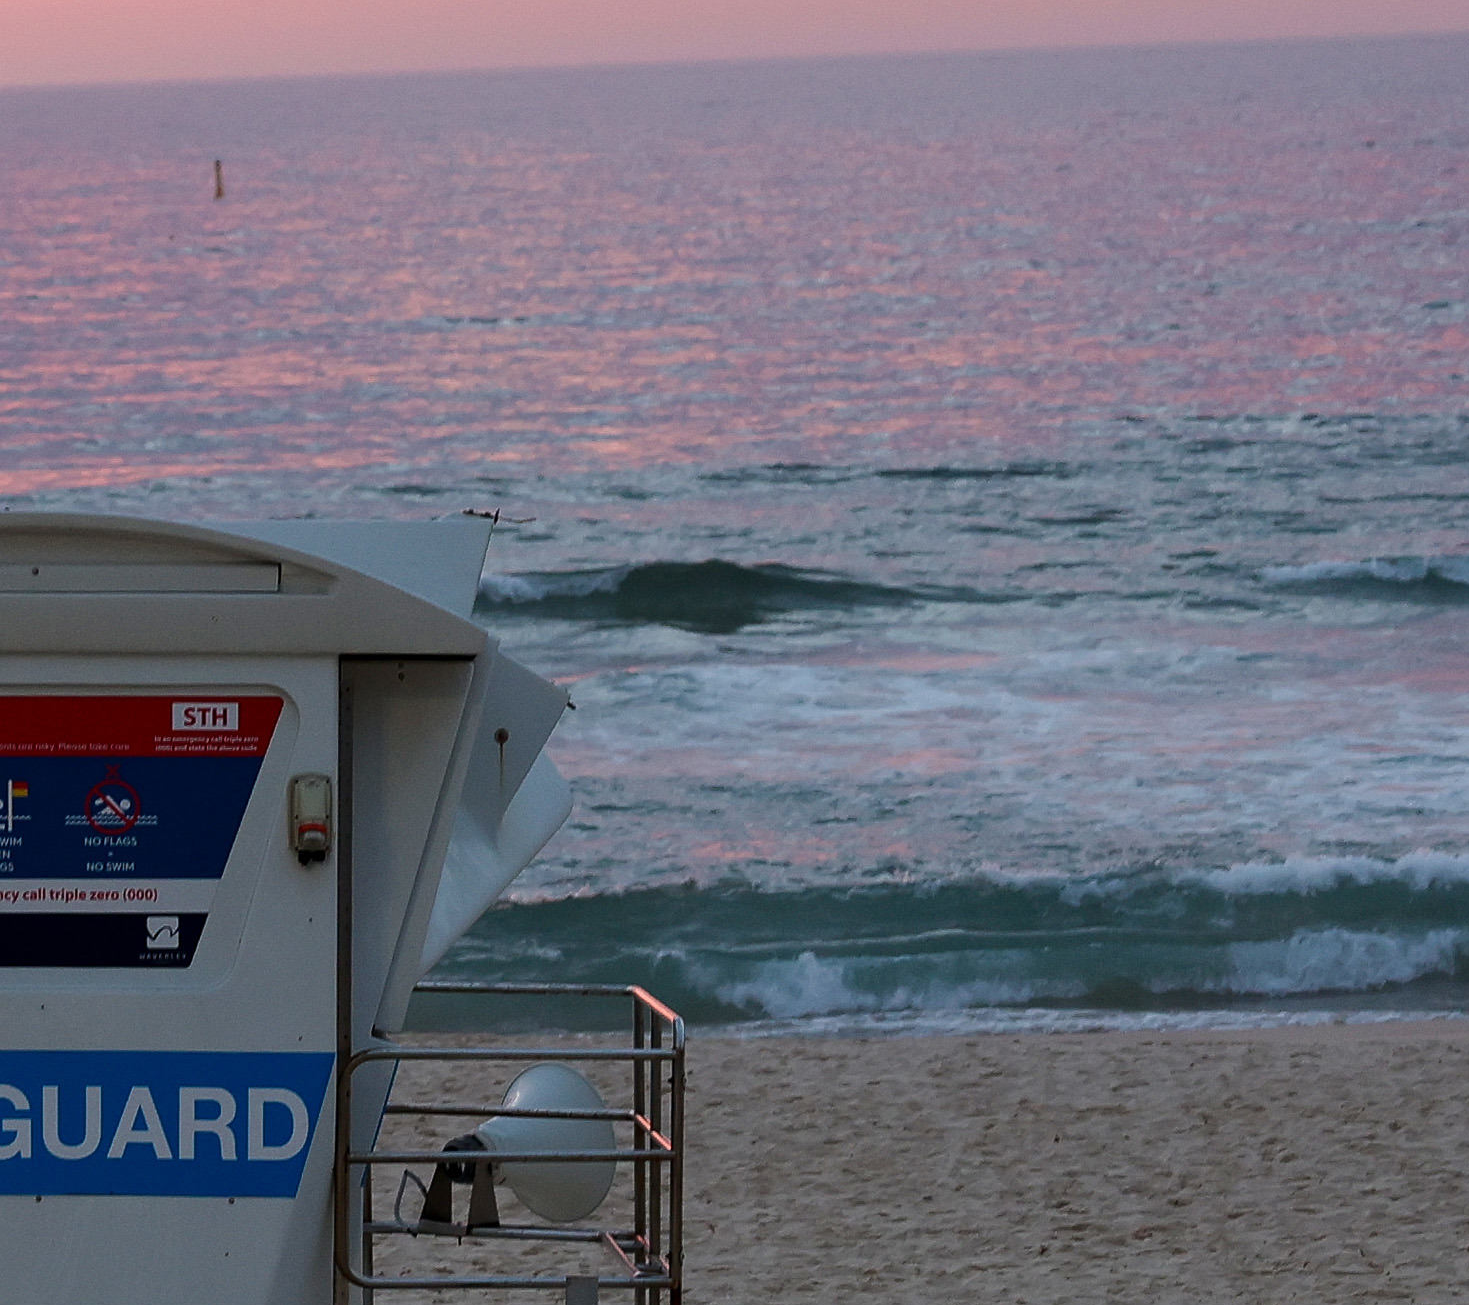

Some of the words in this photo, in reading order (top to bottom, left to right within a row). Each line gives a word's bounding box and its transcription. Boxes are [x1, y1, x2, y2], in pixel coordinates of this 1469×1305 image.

[183, 707, 228, 726] STH
[84, 836, 101, 846] NO
[103, 836, 137, 846] FLAGS
[86, 862, 103, 872] NO
[106, 862, 135, 872] SWIM
[22, 888, 46, 900] call
[50, 888, 86, 903] triple
[90, 891, 119, 900] zero
[123, 888, 158, 903] (000)
